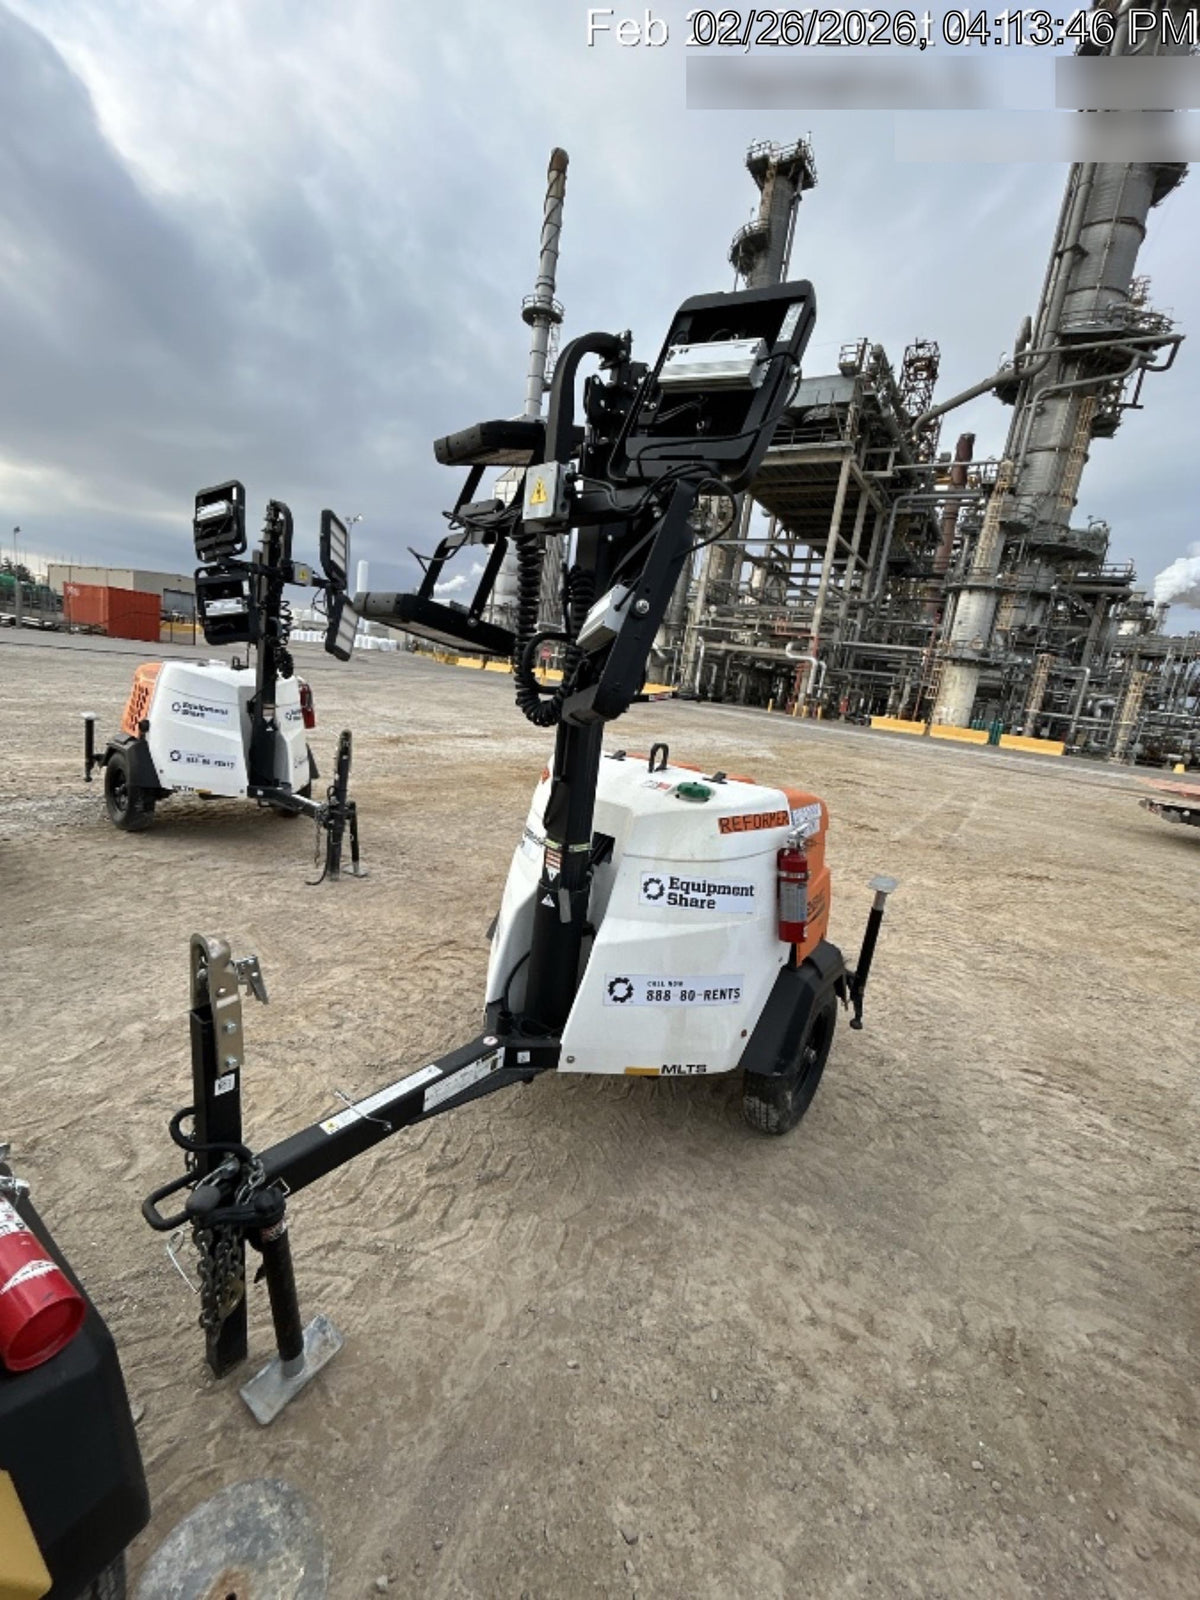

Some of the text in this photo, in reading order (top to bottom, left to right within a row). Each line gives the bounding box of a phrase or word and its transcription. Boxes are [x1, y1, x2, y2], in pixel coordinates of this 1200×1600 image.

[718, 811, 790, 834] REFORMER
[668, 876, 754, 897] Equipment
[667, 892, 716, 909] Share
[661, 1064, 707, 1075] MLTS
